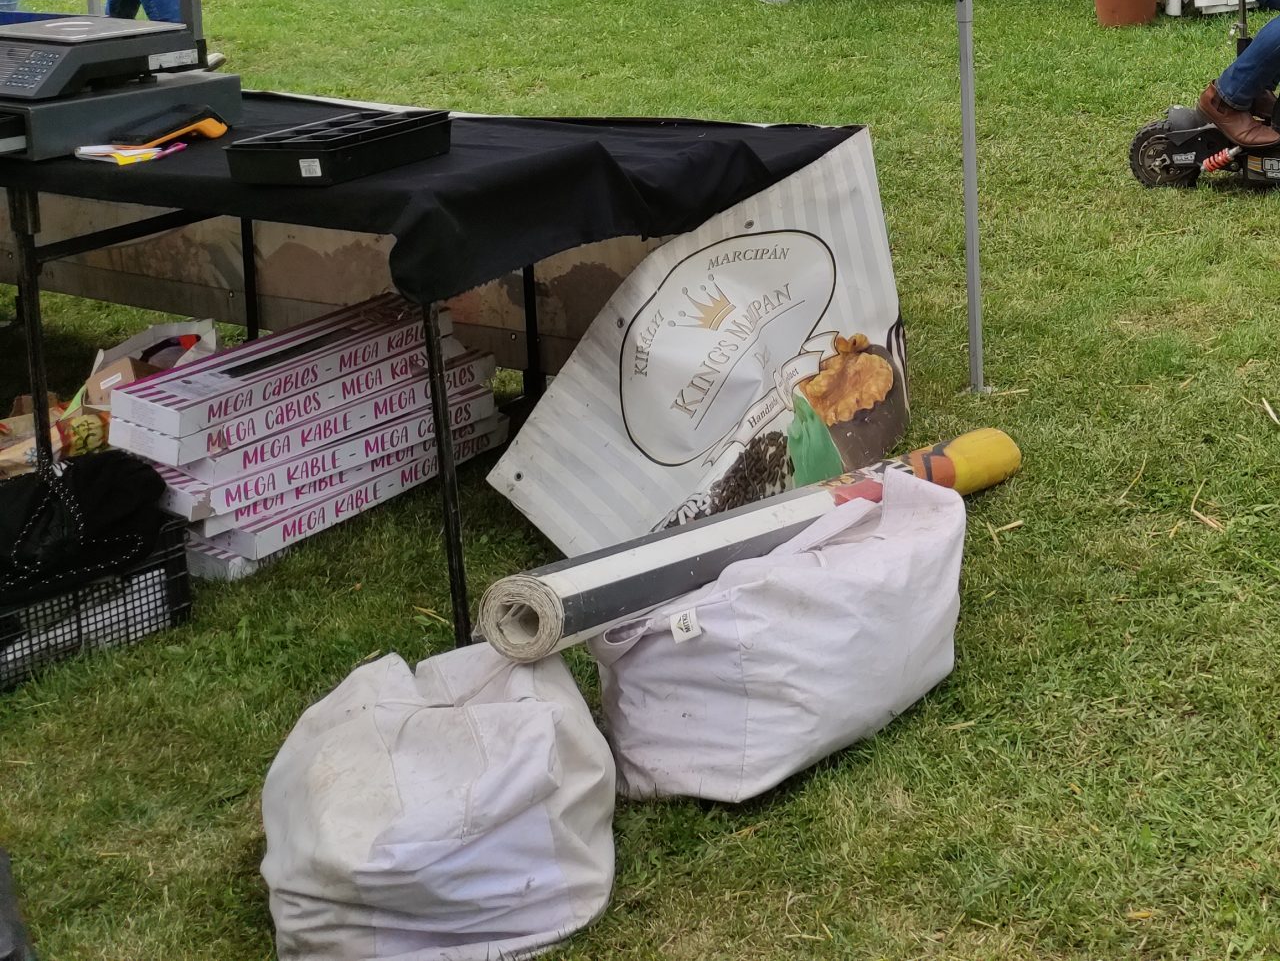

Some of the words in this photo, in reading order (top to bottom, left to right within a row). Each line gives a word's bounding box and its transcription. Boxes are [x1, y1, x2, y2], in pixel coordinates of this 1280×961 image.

[707, 244, 790, 271] MARCIPÁN
[208, 389, 253, 423] MEGA
[339, 341, 379, 372] MEGA
[633, 309, 666, 377] KIRÁLYI
[207, 417, 256, 452] MEGA
[342, 368, 383, 400] MEGA
[243, 435, 291, 469] MEGA
[301, 411, 352, 447] KABLE
[374, 387, 416, 419] MEGA
[225, 473, 276, 507] MEGA
[287, 449, 340, 485] KABLE
[364, 425, 409, 458] MEGA
[283, 506, 325, 542] MEGA
[335, 480, 381, 518] KABLE
[401, 455, 438, 488] MEGA
